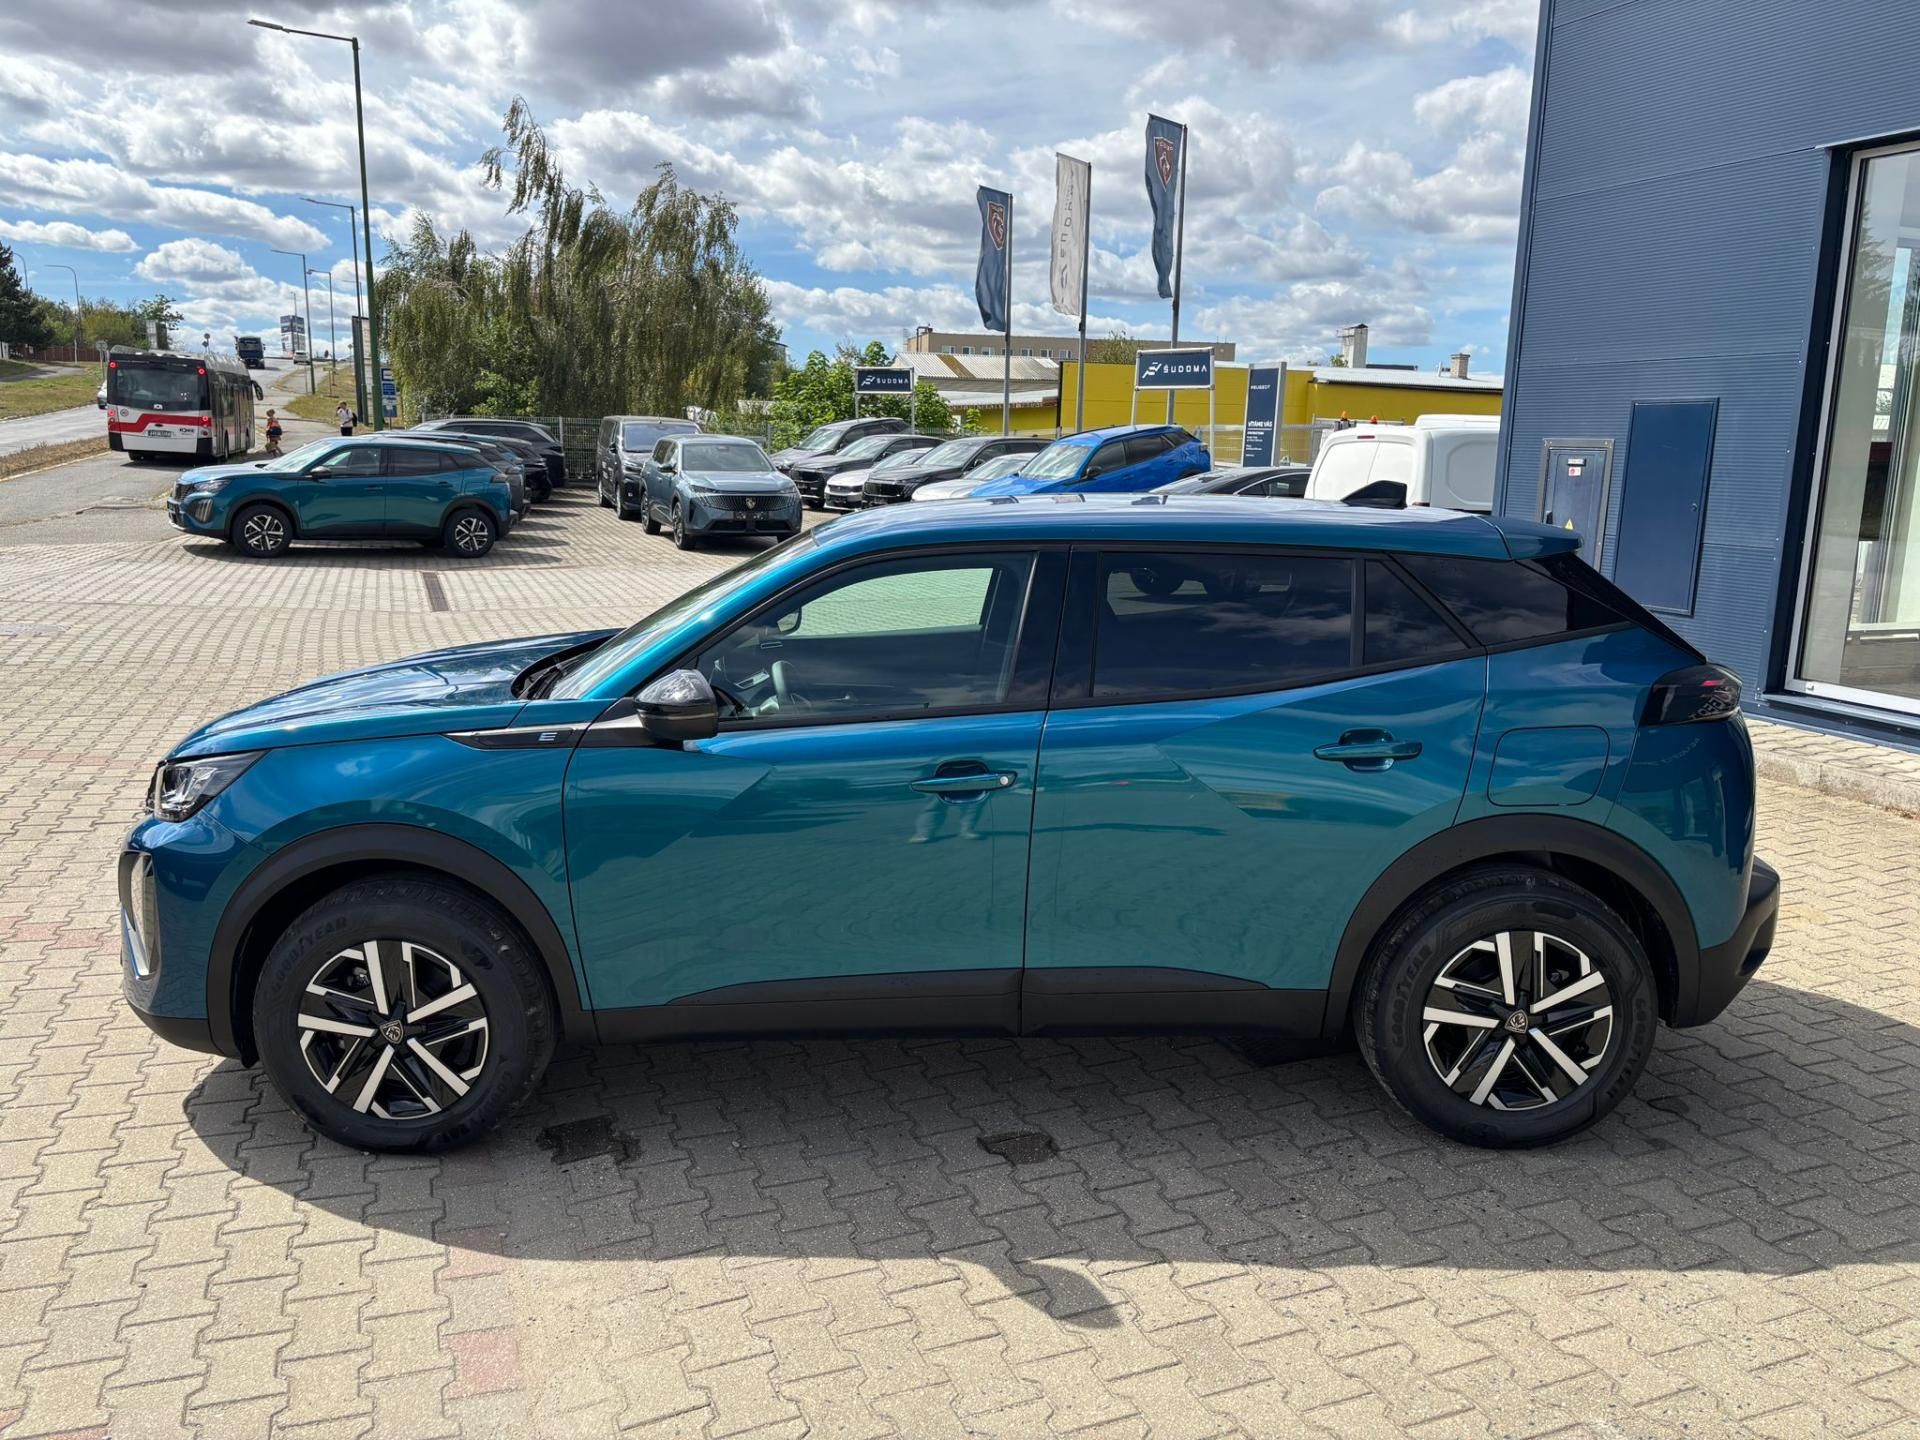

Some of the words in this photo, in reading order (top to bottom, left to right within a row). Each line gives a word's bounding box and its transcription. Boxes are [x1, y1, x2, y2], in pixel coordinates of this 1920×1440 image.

[1163, 364, 1208, 374] ŠUDOMA
[272, 915, 349, 994] GOODYEAR
[1389, 944, 1434, 1049] GOODYEAR
